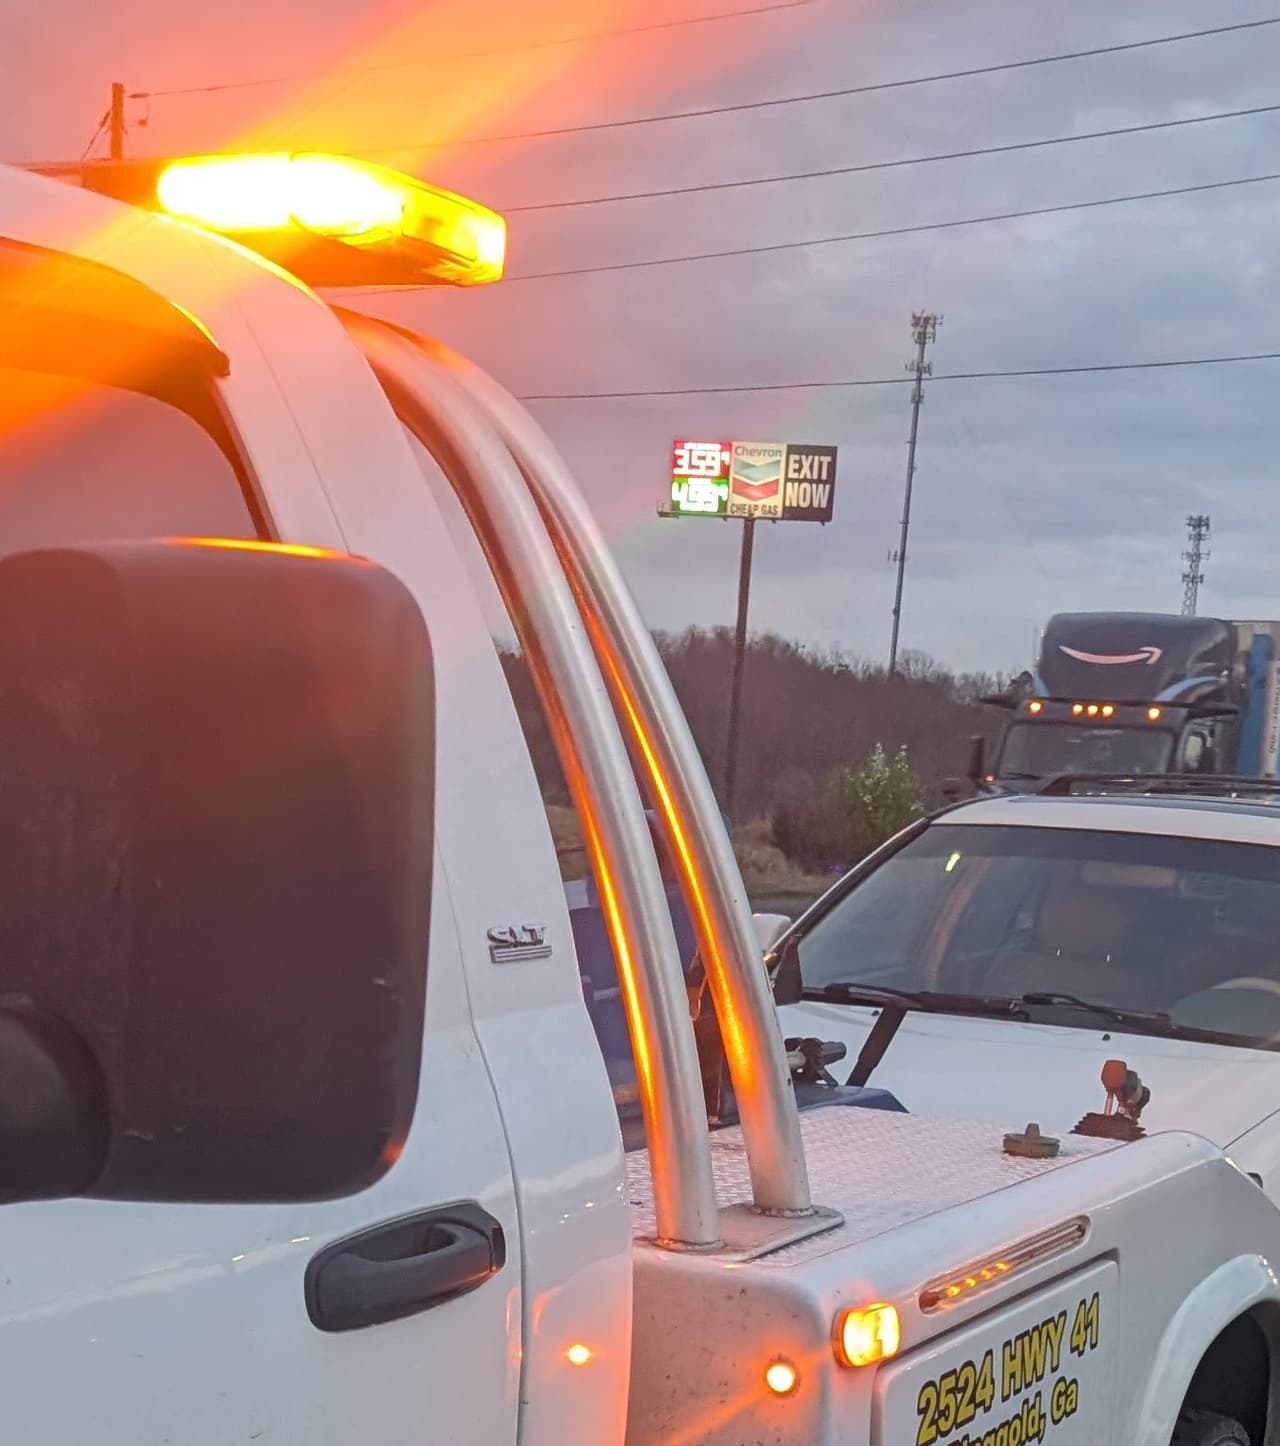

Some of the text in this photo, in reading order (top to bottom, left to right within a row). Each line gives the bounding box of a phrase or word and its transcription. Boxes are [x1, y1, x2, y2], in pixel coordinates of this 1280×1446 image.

[734, 445, 782, 458] Chevron
[788, 454, 832, 480] EXIT
[785, 482, 830, 508] NOW
[730, 503, 778, 516] CHEAP GAS
[1001, 1311, 1068, 1401] HWY
[1070, 1292, 1100, 1357] 41
[1051, 1375, 1080, 1425] Ga
